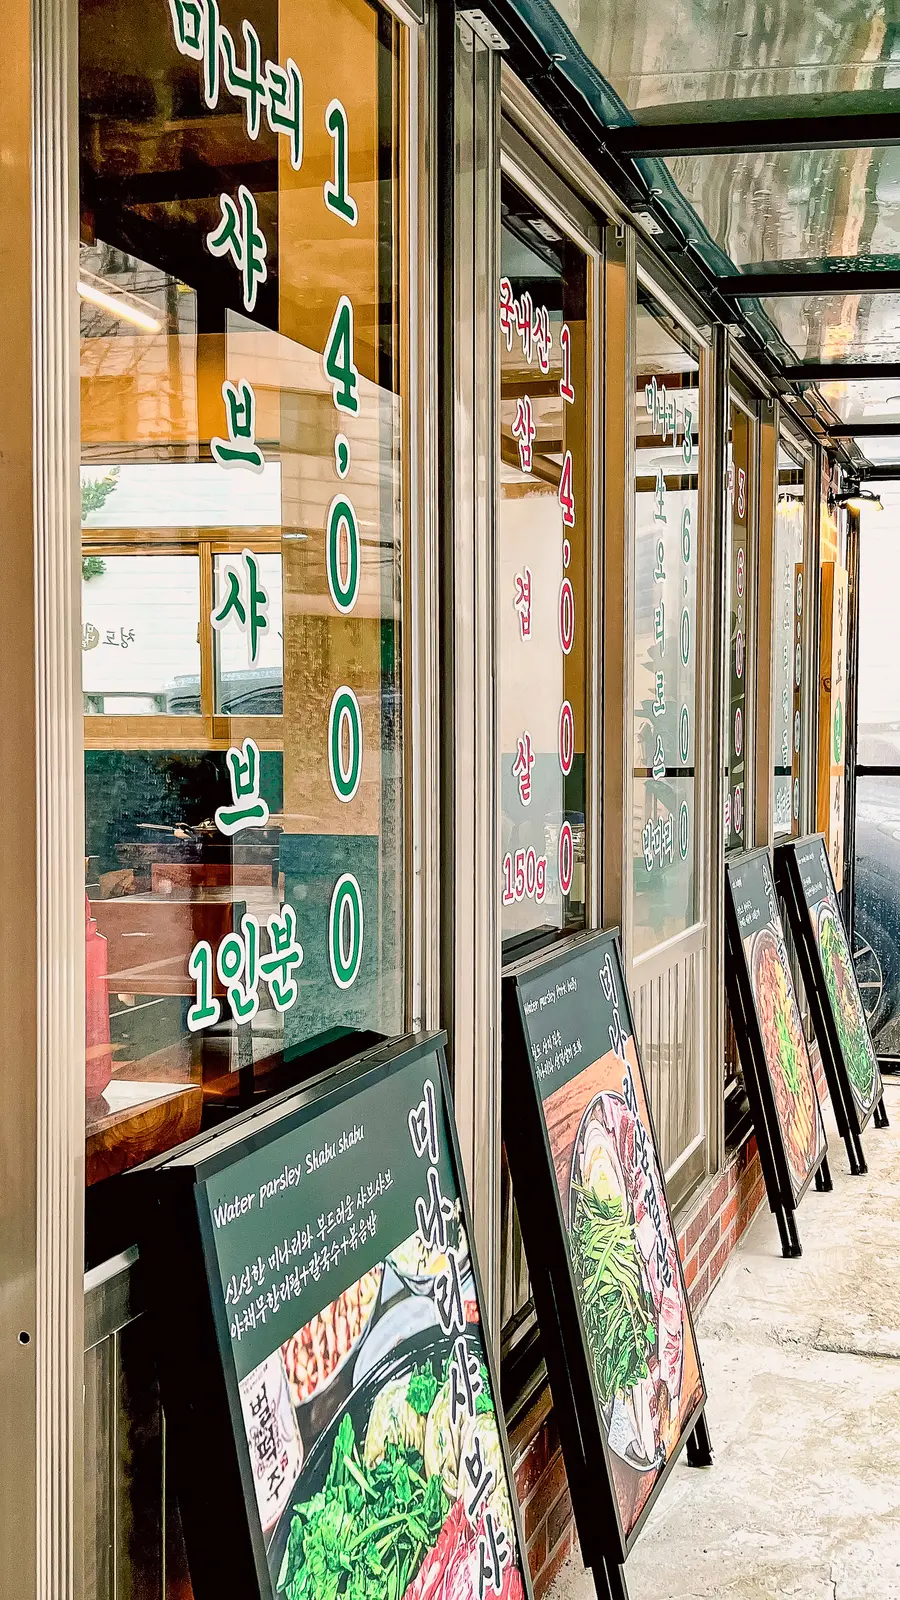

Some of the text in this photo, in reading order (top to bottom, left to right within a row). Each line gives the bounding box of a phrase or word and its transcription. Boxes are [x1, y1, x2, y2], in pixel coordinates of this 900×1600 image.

[168, 0, 304, 171] 미나리
[500, 277, 552, 374] 국내산
[645, 376, 677, 448] 미나리
[206, 185, 270, 837] 샤브샤브
[322, 98, 364, 990] 14,000
[512, 394, 537, 806] 삼겹살
[558, 323, 576, 896] 14,000
[679, 406, 693, 861] 36,000
[502, 846, 547, 906] 150g
[642, 812, 674, 872] 반마리
[186, 903, 303, 1033] 1인분
[213, 1124, 365, 1229] Water parsley Shabu shabu
[225, 1168, 394, 1305] 신선한 미나리와 부드러운 샤브샤브
